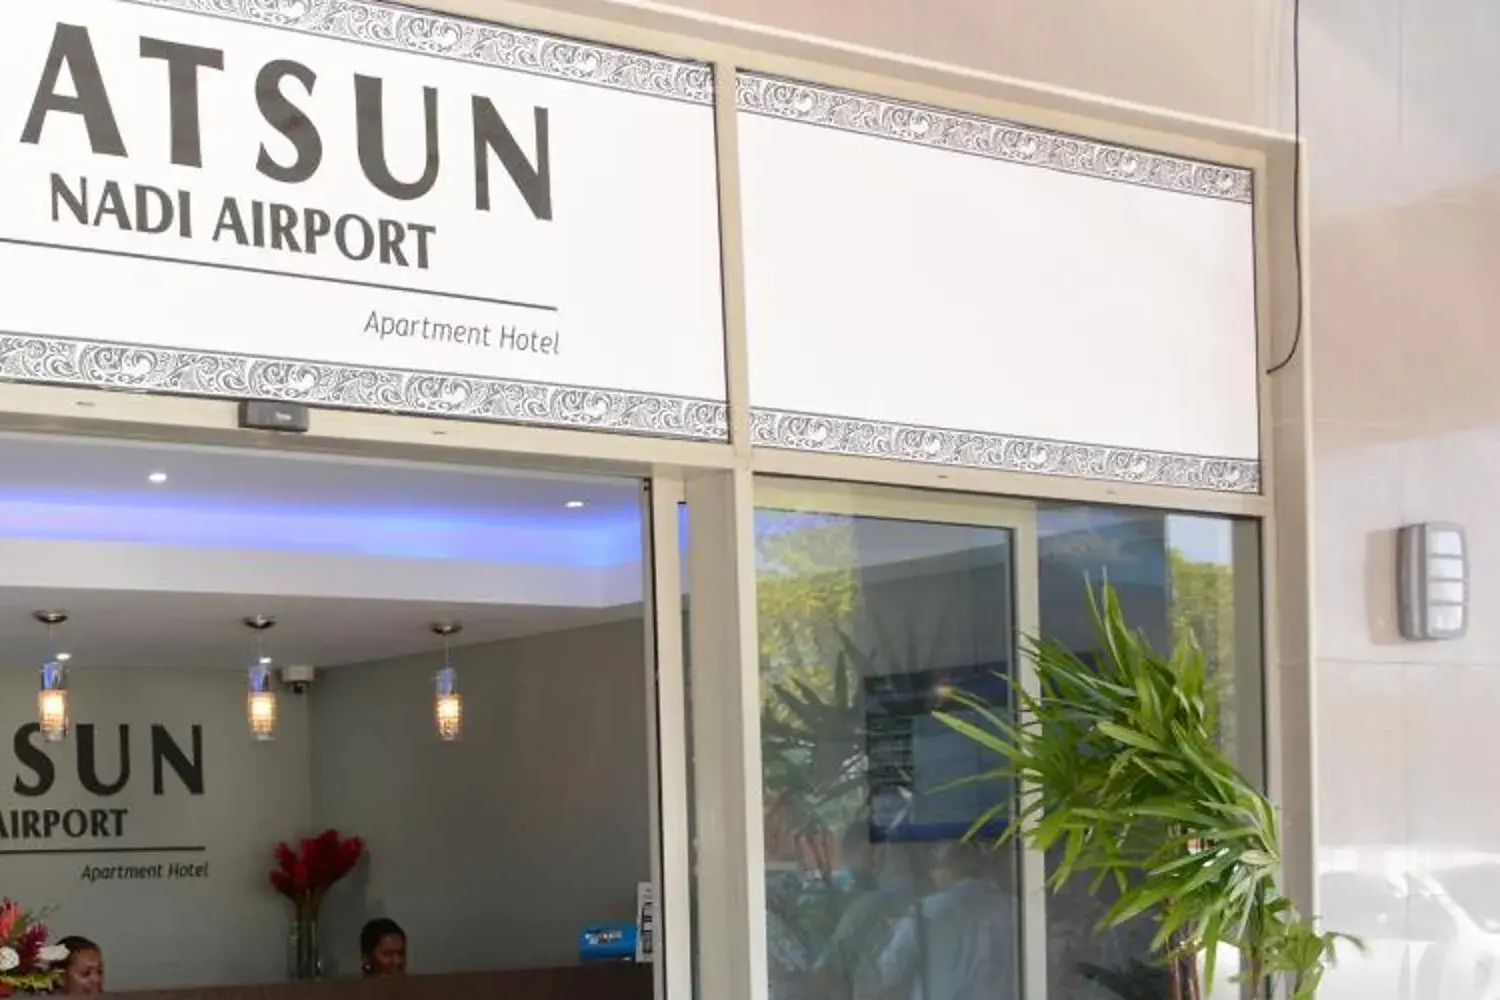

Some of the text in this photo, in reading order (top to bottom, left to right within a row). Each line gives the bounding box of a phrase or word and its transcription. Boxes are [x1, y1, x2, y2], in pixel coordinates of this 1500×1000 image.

[49, 172, 436, 270] NADI AIRPORT
[363, 311, 561, 355] Apartment Hotel
[81, 861, 209, 882] Apartment Hotel
